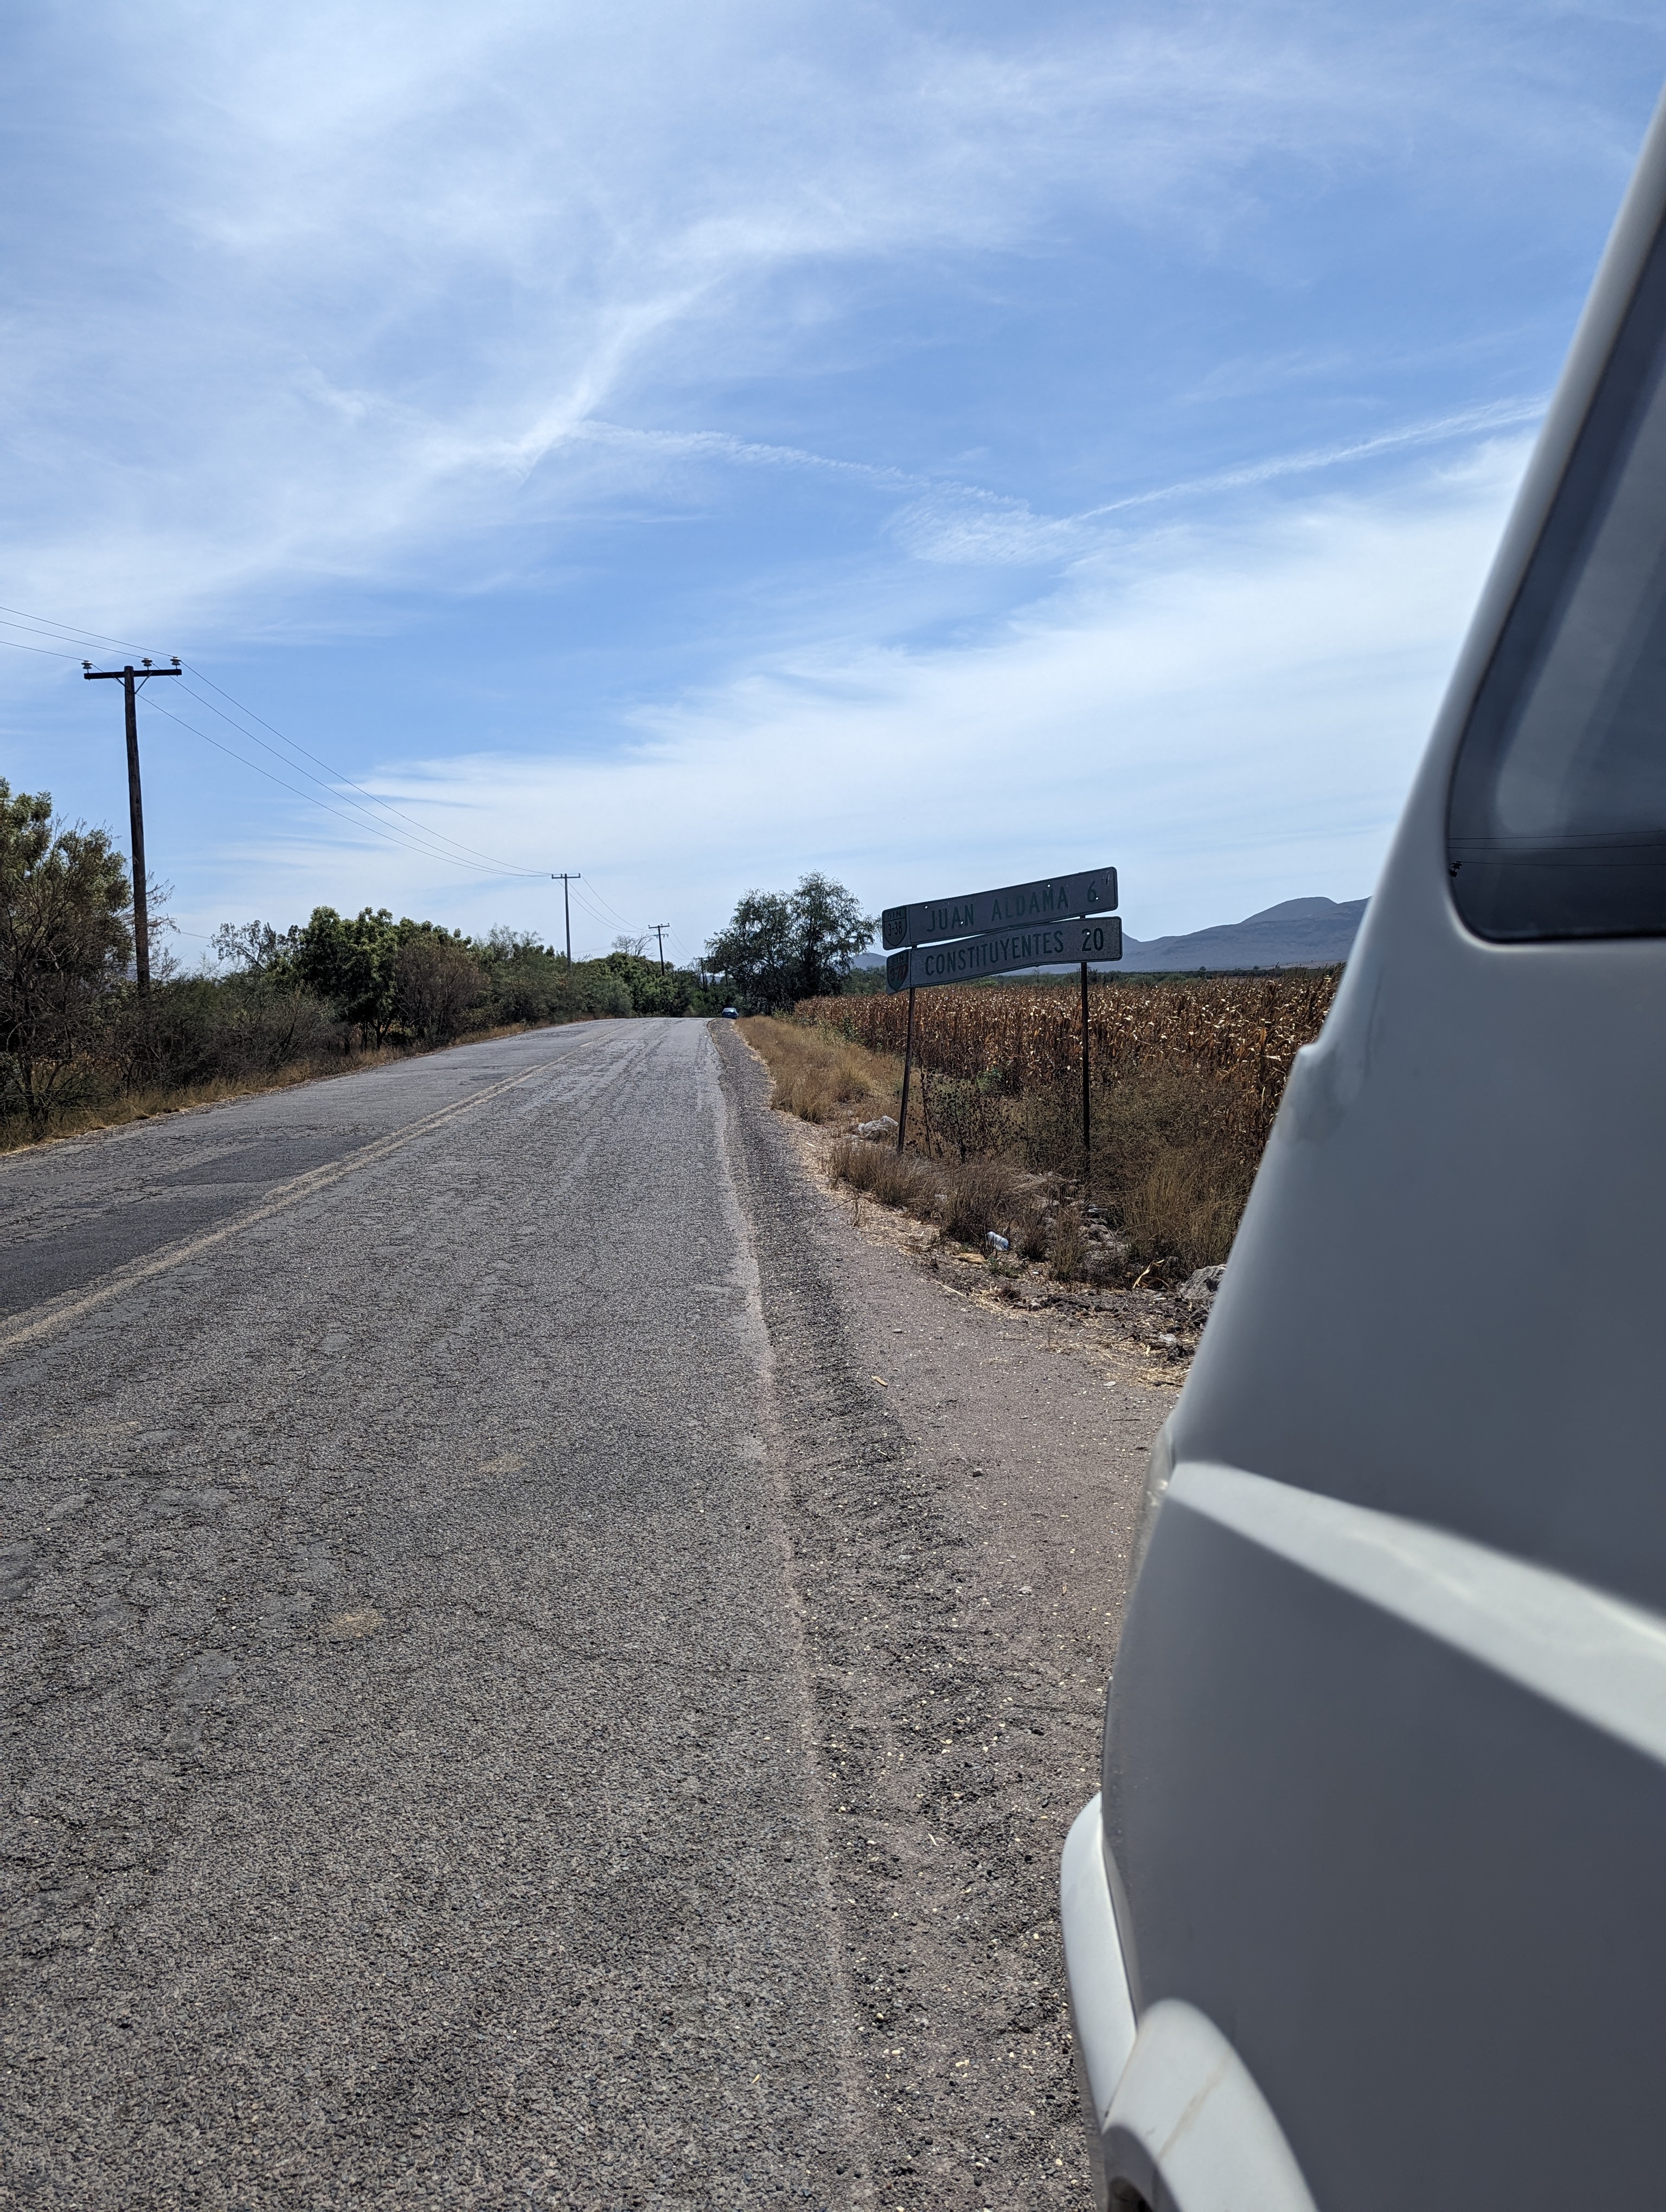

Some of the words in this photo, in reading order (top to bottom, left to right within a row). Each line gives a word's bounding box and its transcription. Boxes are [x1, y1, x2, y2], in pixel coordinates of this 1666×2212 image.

[926, 904, 975, 933] JUAN
[991, 886, 1069, 922] ALDAMA
[1087, 880, 1097, 903] 6
[887, 910, 901, 919] SIN
[888, 921, 902, 936] 3-38
[925, 931, 1063, 976] CONSTITUYENTES
[1081, 927, 1104, 951] 20
[892, 954, 904, 965] SIN
